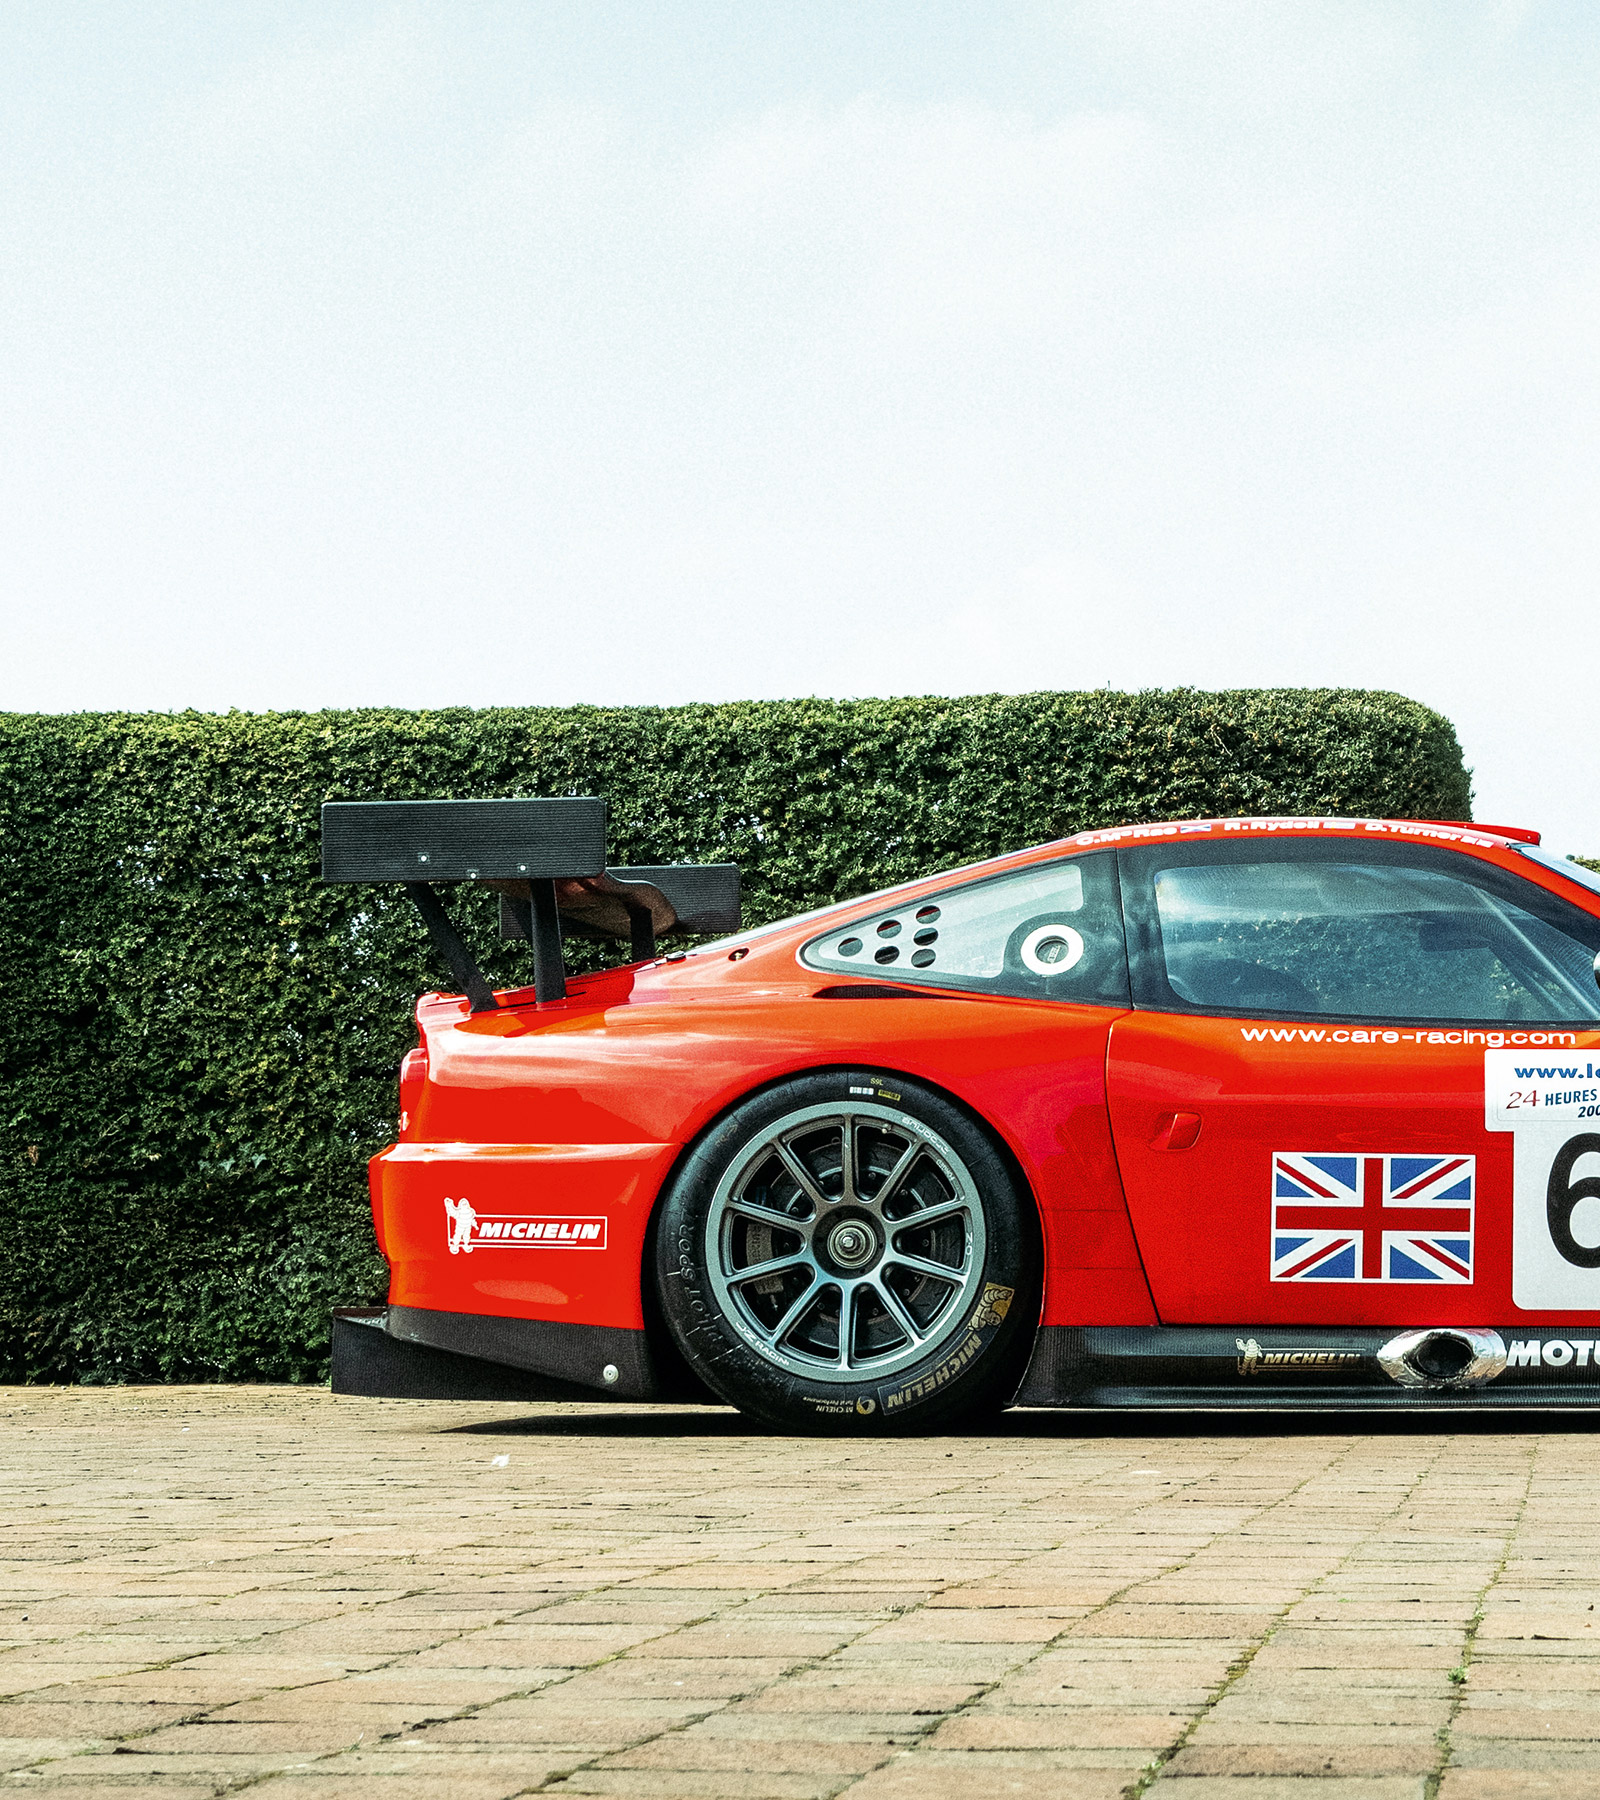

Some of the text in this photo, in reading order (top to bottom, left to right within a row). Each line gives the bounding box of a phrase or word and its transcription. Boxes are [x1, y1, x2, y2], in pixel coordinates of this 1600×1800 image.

[1223, 820, 1320, 832] R.Rydell
[1364, 822, 1462, 842] D.Turner
[1240, 1028, 1577, 1048] www.care-racing.com
[1505, 1089, 1541, 1110] 24
[1544, 1088, 1598, 1107] HEURES
[478, 1222, 602, 1240] MICHELIN
[754, 1340, 790, 1367] RACIN
[1263, 1352, 1361, 1366] MICHELIN
[886, 1332, 984, 1409] MICHELIN
